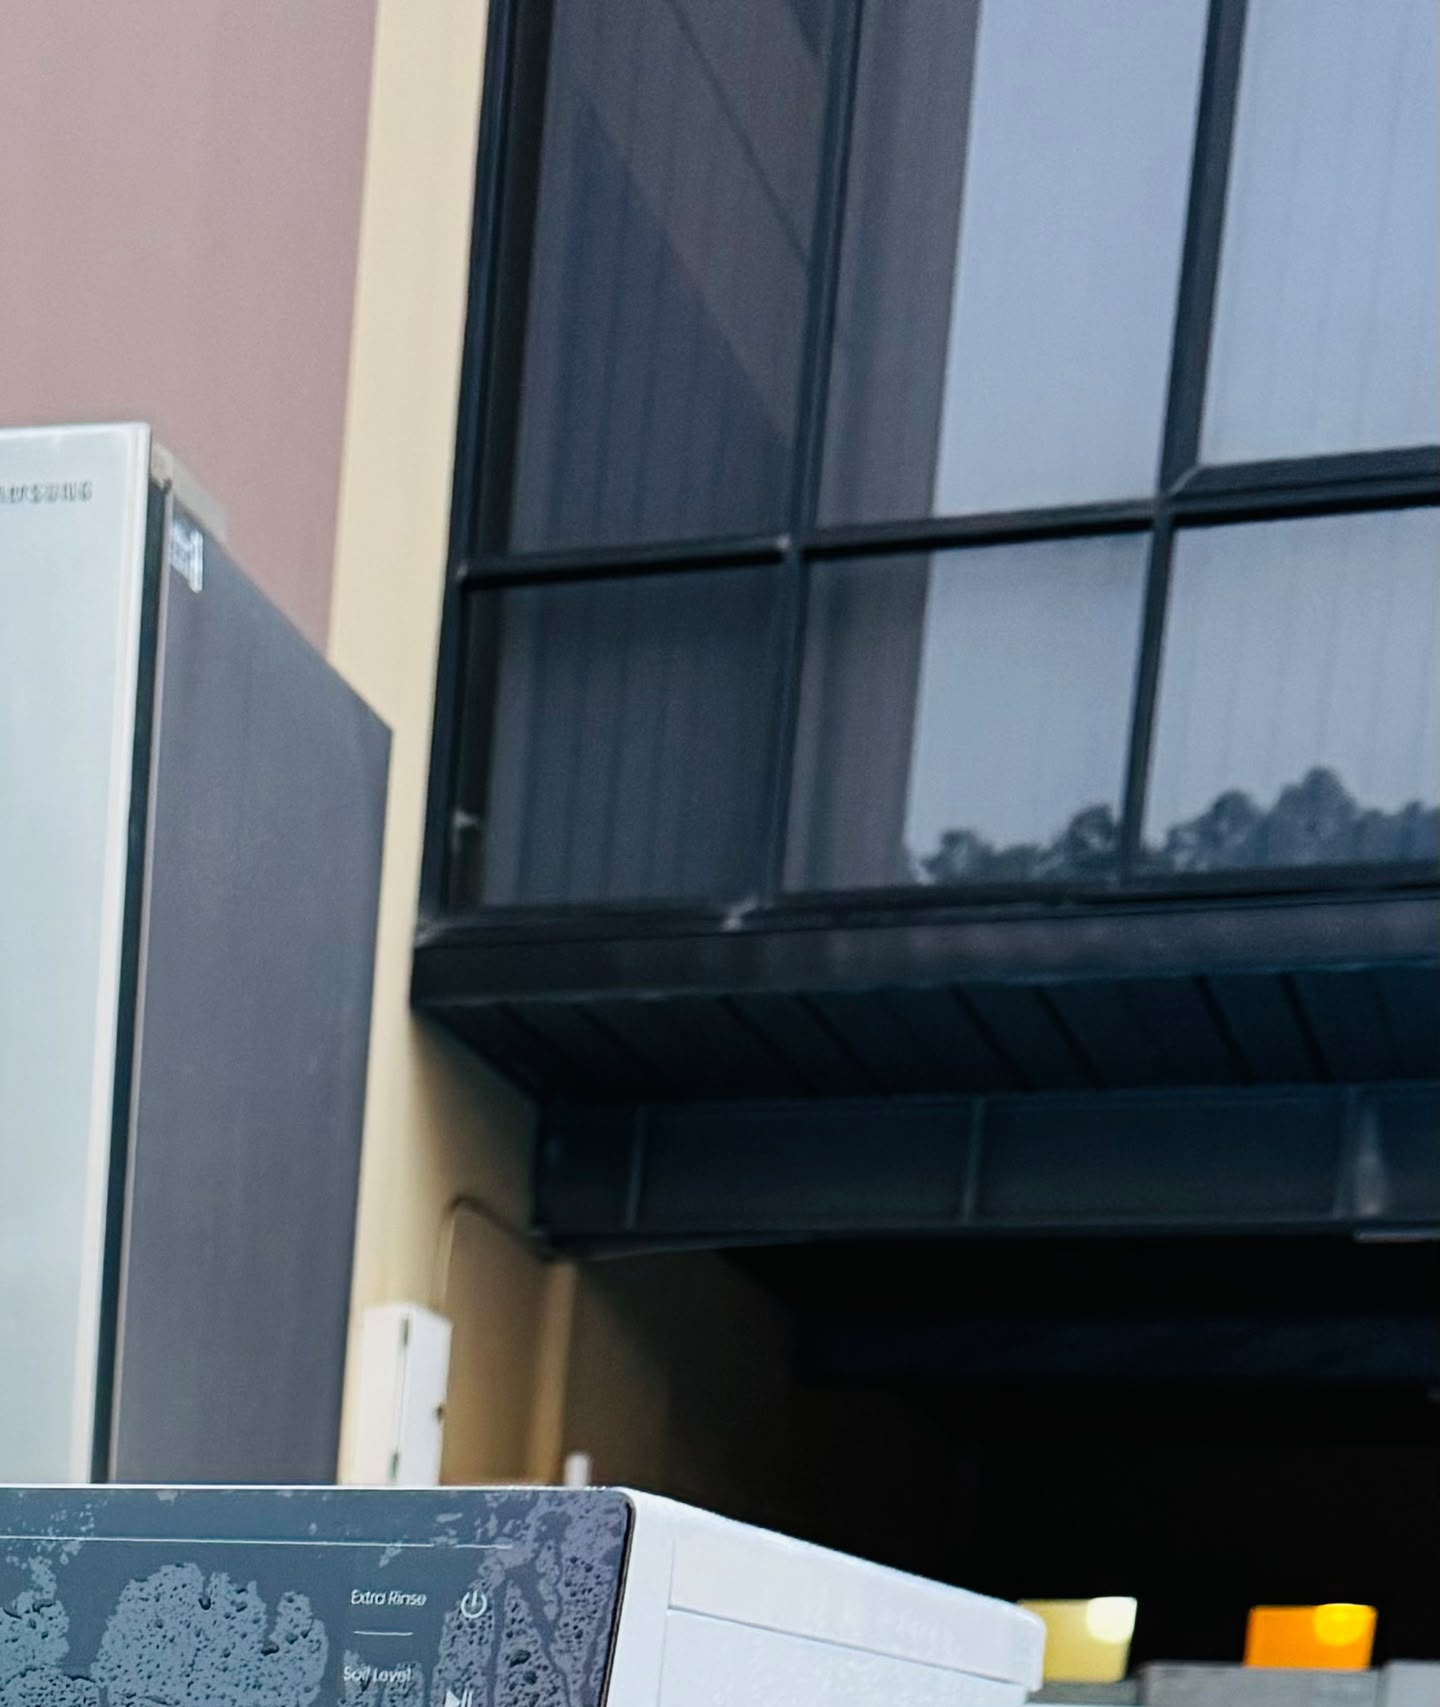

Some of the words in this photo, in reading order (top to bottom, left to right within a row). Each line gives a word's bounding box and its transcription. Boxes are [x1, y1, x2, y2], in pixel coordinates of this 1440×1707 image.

[350, 1589, 386, 1605] Extra
[388, 1590, 427, 1607] Rinse
[343, 1665, 372, 1681] Soil
[372, 1667, 412, 1683] Level
